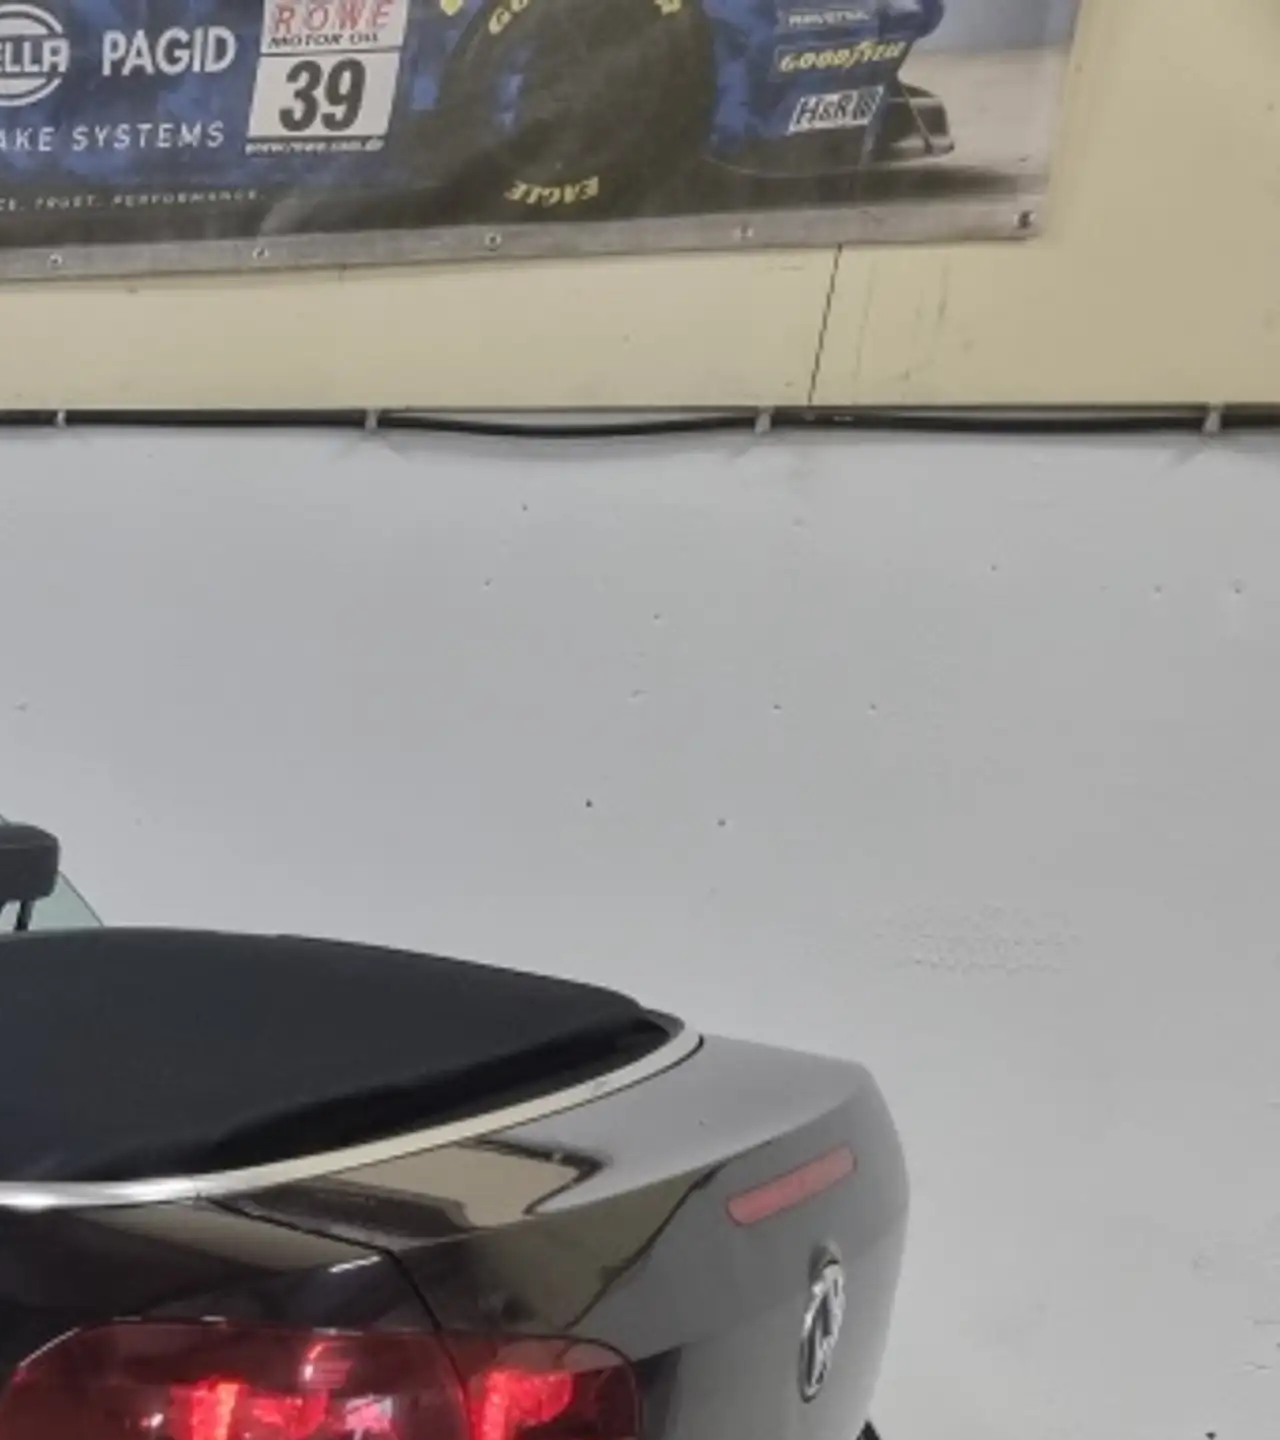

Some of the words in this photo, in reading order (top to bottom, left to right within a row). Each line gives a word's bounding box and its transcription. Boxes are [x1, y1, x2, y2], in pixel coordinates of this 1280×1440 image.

[101, 25, 238, 77] PAGID
[279, 57, 367, 133] 39
[71, 119, 227, 153] SYSTEMS
